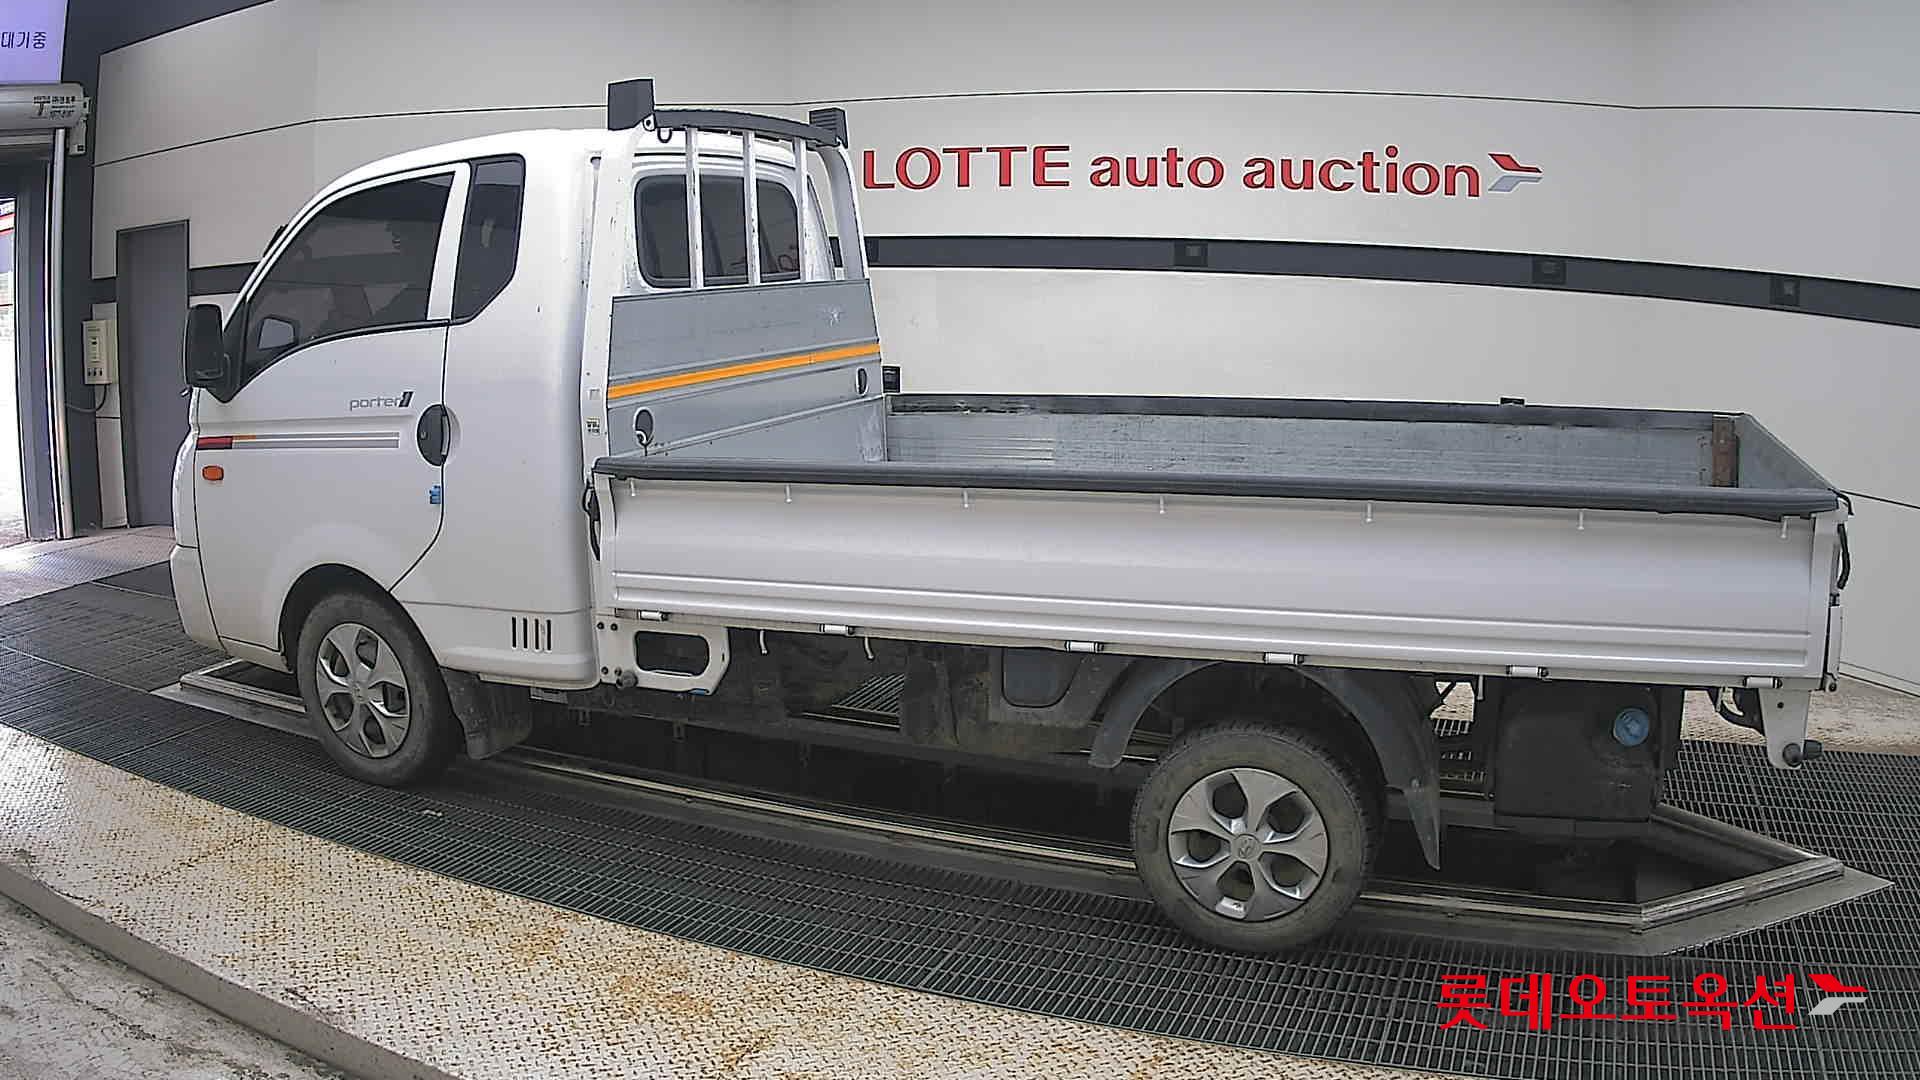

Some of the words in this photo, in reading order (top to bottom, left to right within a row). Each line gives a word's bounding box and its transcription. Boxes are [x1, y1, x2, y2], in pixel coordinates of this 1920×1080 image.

[863, 145, 1071, 190] LOTTE
[1089, 147, 1225, 188] auto
[1242, 145, 1481, 197] auction
